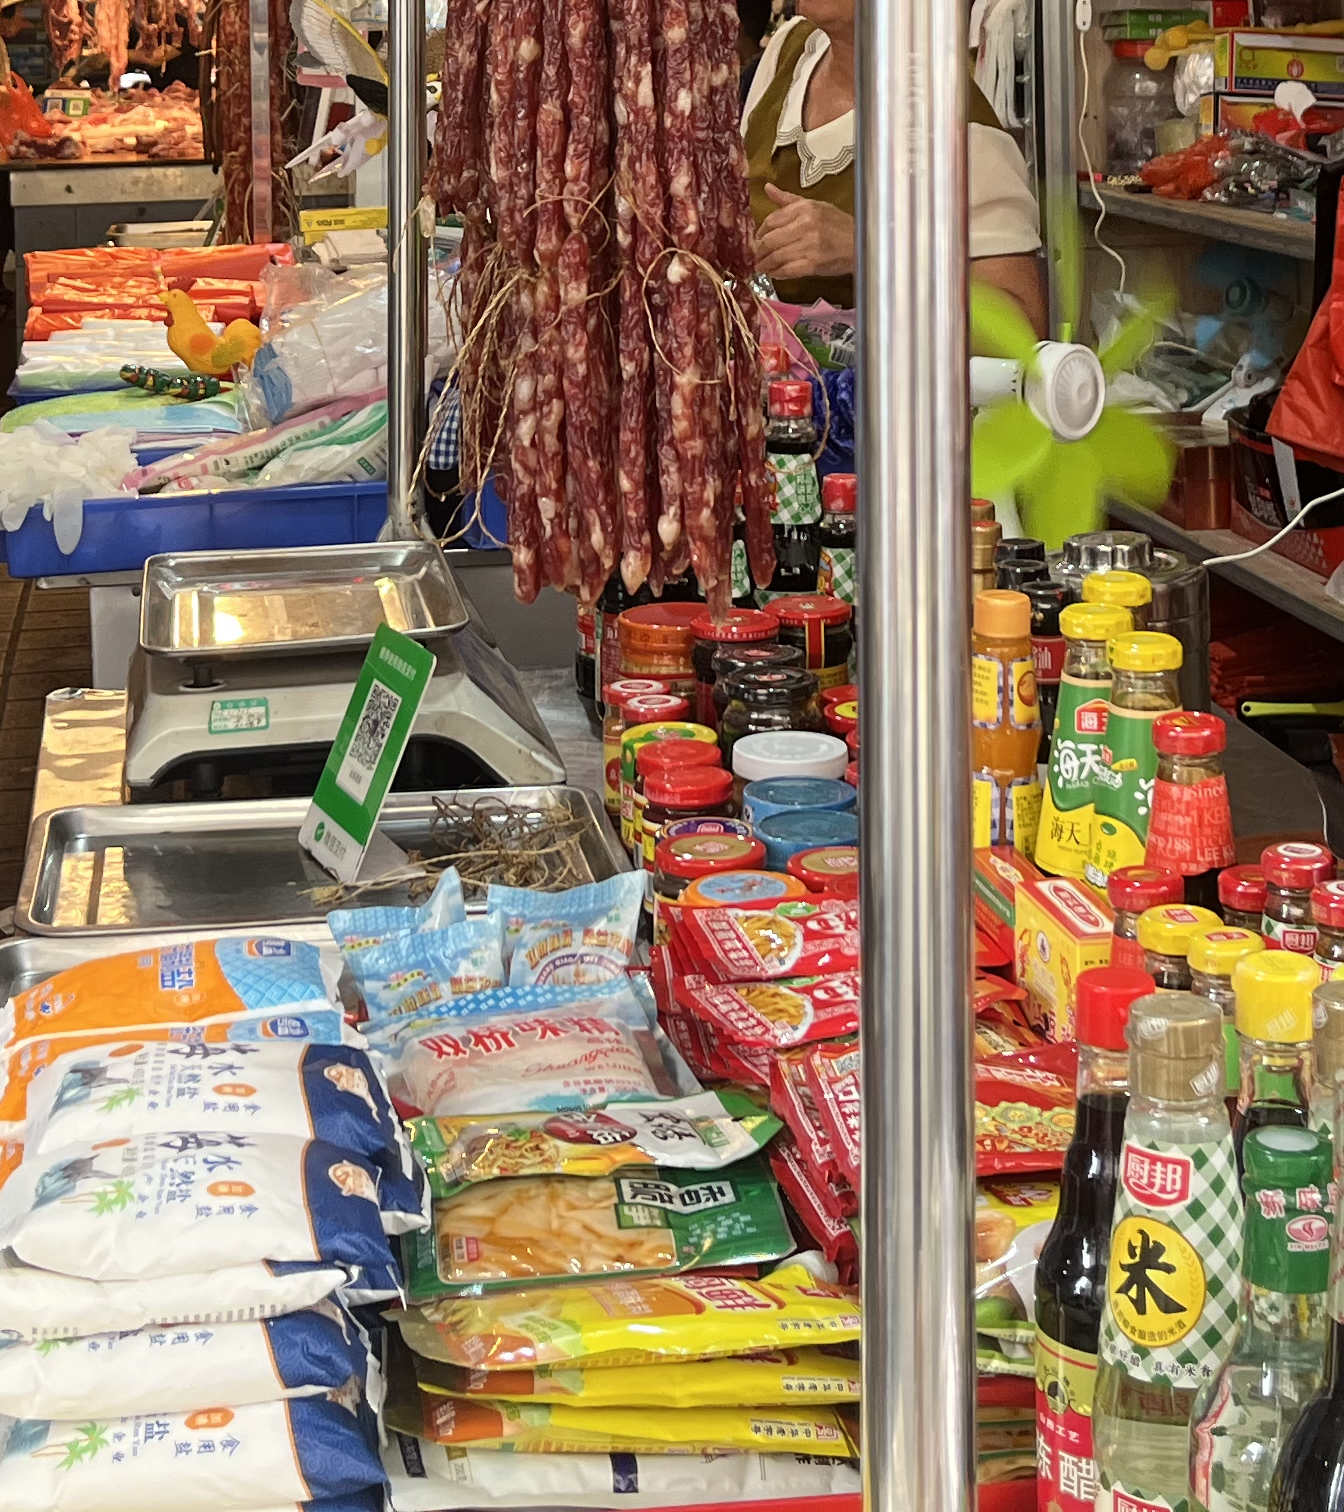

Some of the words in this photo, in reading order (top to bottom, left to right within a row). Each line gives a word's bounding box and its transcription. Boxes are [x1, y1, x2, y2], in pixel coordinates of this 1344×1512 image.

[1050, 815, 1081, 845] 海天
[418, 1015, 621, 1060] 双桥味精
[202, 1100, 262, 1115] 食用盐
[1125, 1153, 1185, 1198] 厨邦
[195, 1204, 260, 1220] 食用盐
[1116, 1228, 1188, 1316] 米
[149, 1330, 215, 1348] 食用盐
[174, 1433, 242, 1457] 食用盐
